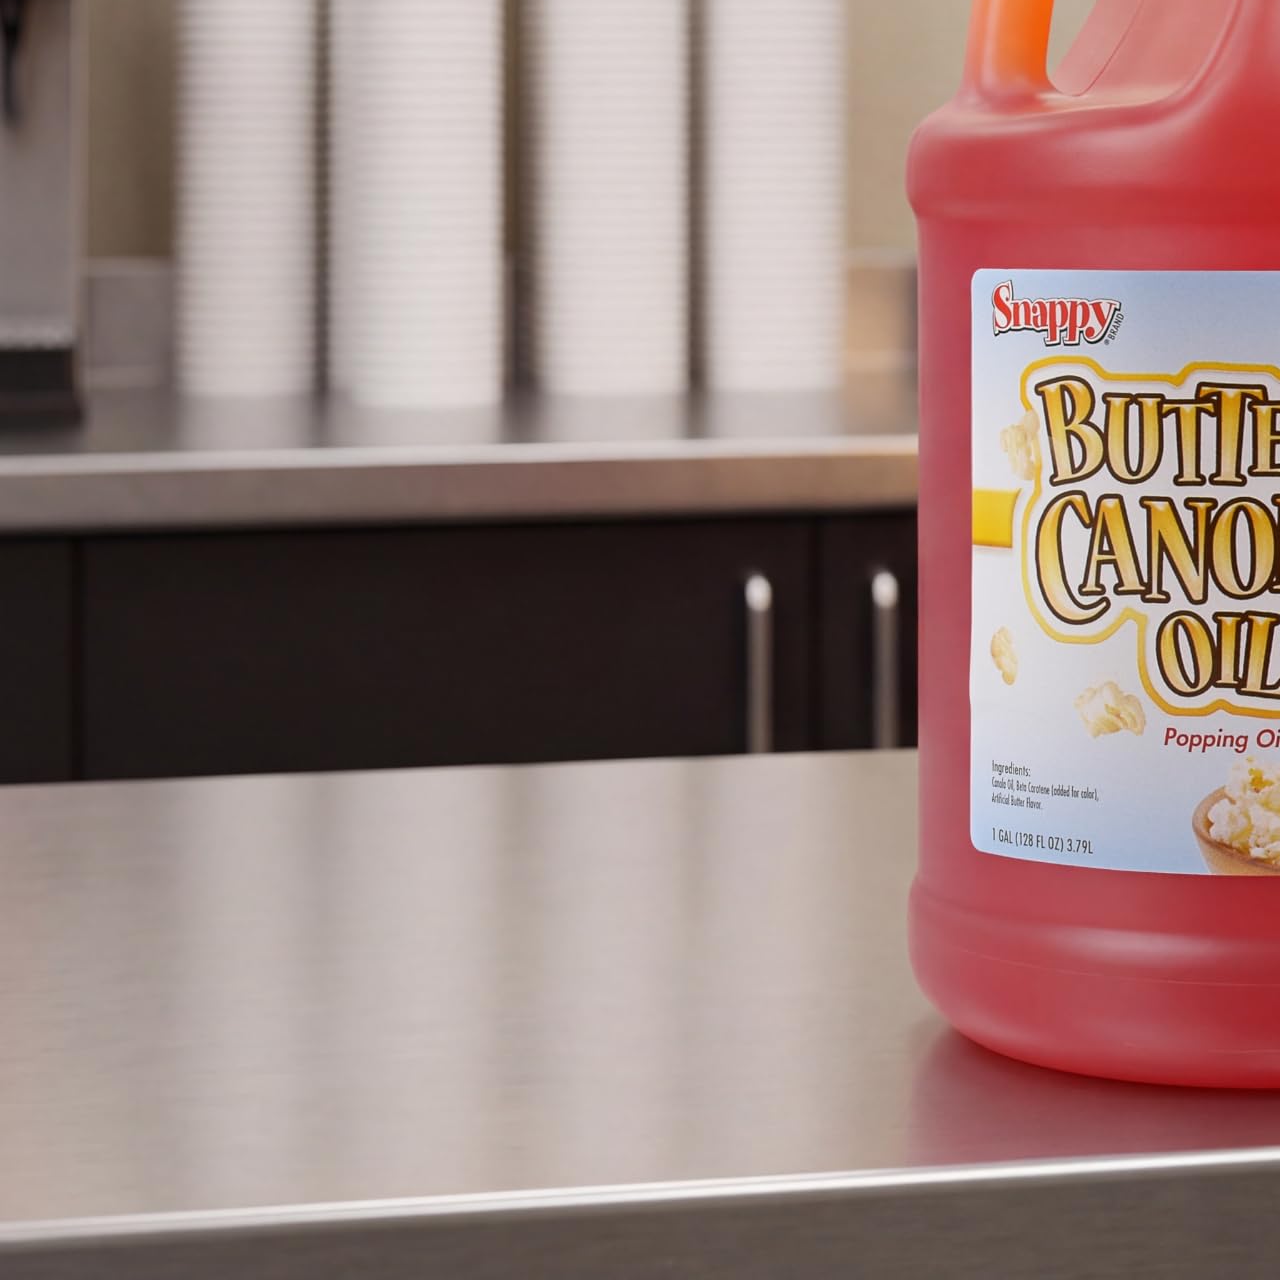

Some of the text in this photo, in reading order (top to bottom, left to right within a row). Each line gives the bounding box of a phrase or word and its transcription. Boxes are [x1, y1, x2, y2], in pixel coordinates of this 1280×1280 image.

[993, 280, 1121, 346] Snappy
[1108, 313, 1124, 340] BRAND
[1164, 728, 1248, 753] Popping
[992, 760, 1030, 776] Ingredients:
[992, 777, 1006, 788] Canola
[1016, 781, 1026, 791] Beta
[1028, 782, 1050, 794] Carotene
[1051, 784, 1070, 797] (added
[992, 793, 1010, 805] Artificial
[1011, 795, 1024, 806] Butter
[992, 828, 1093, 854] 1 GAL (128 FL OZ) 3.79L
